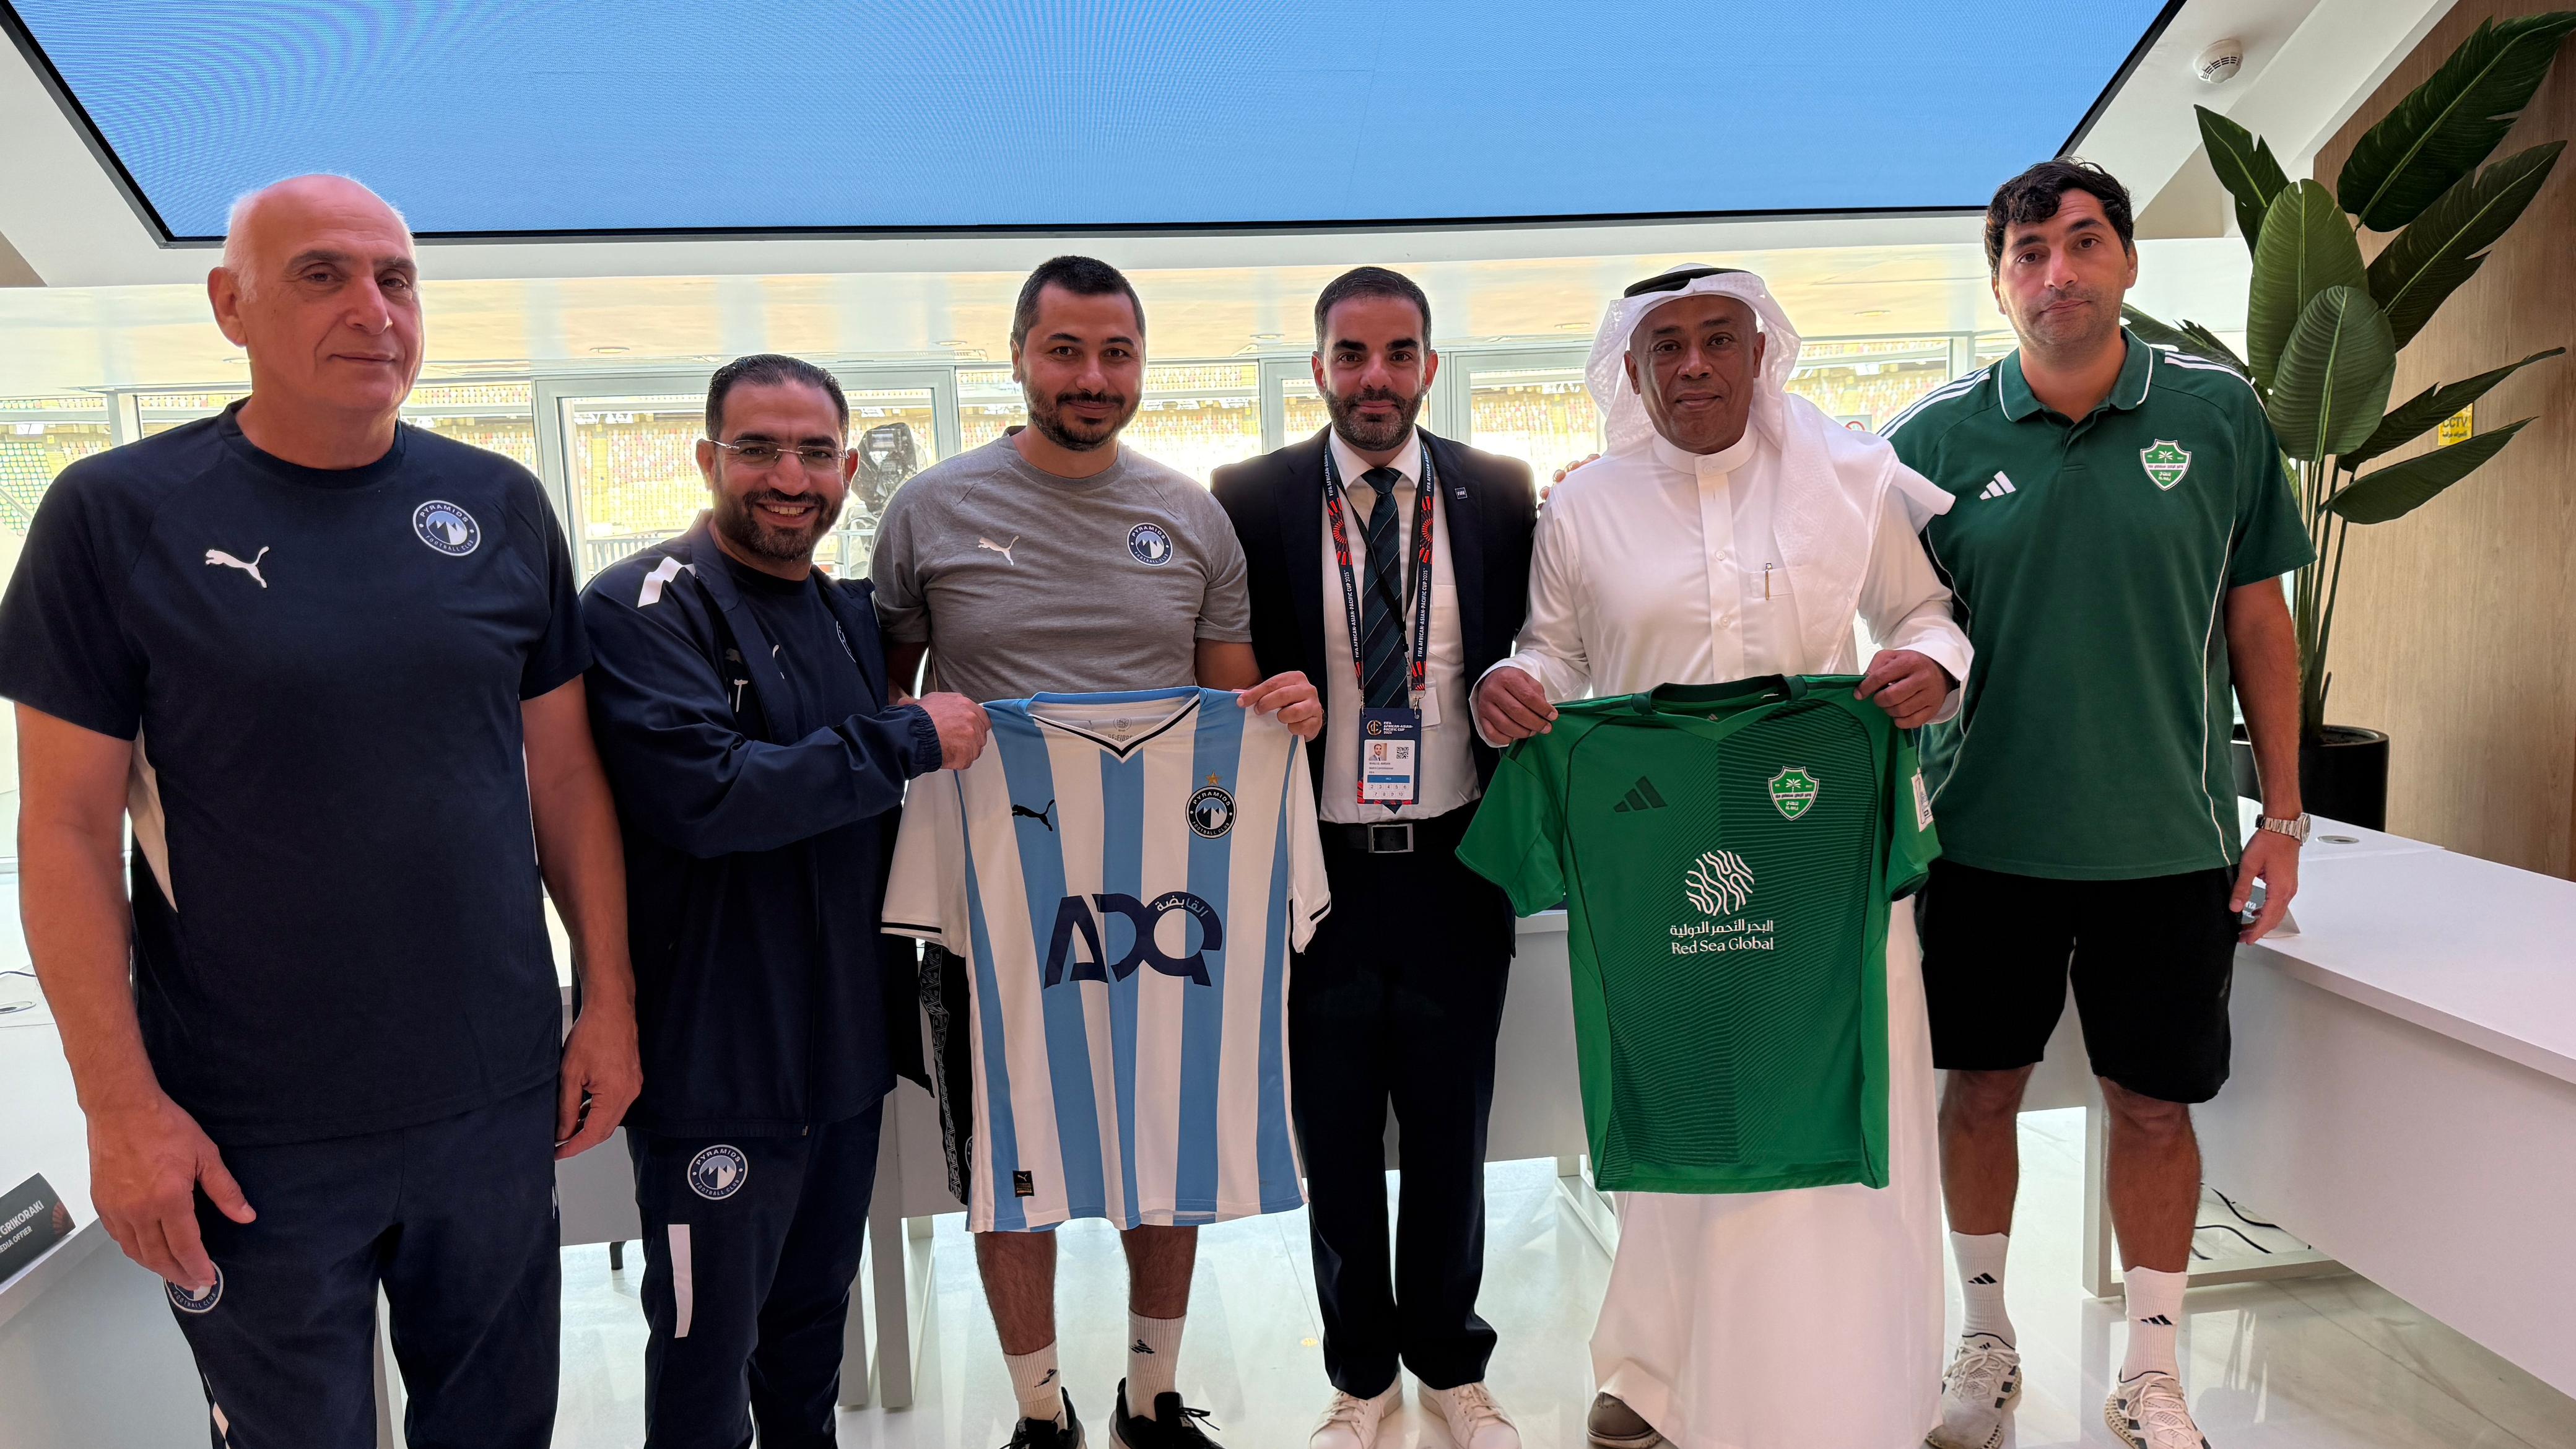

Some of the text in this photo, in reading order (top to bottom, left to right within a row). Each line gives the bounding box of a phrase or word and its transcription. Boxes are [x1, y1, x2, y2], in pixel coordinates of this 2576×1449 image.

[420, 504, 469, 523] PYRAMIDS
[1131, 526, 1166, 539] PYRAMIDS
[425, 535, 474, 552] FOOTBALL CLUB
[1193, 791, 1230, 806] PYRAMIDS
[1192, 821, 1230, 835] FOOTBALL CLUB
[1154, 895, 1209, 917] القابضة
[1669, 919, 1774, 939] البحر الأحمر الدولية
[1043, 891, 1223, 990] ADQ
[1672, 936, 1774, 954] Red Sea Global
[696, 1149, 741, 1165] PYRAMIDS
[695, 1180, 739, 1196] FOOTBALL CLUB
[0, 1200, 45, 1235] GRIKORAKI
[0, 1225, 33, 1253] EDIA OFFIER
[174, 1291, 216, 1308] FOOTBALL CLUB
